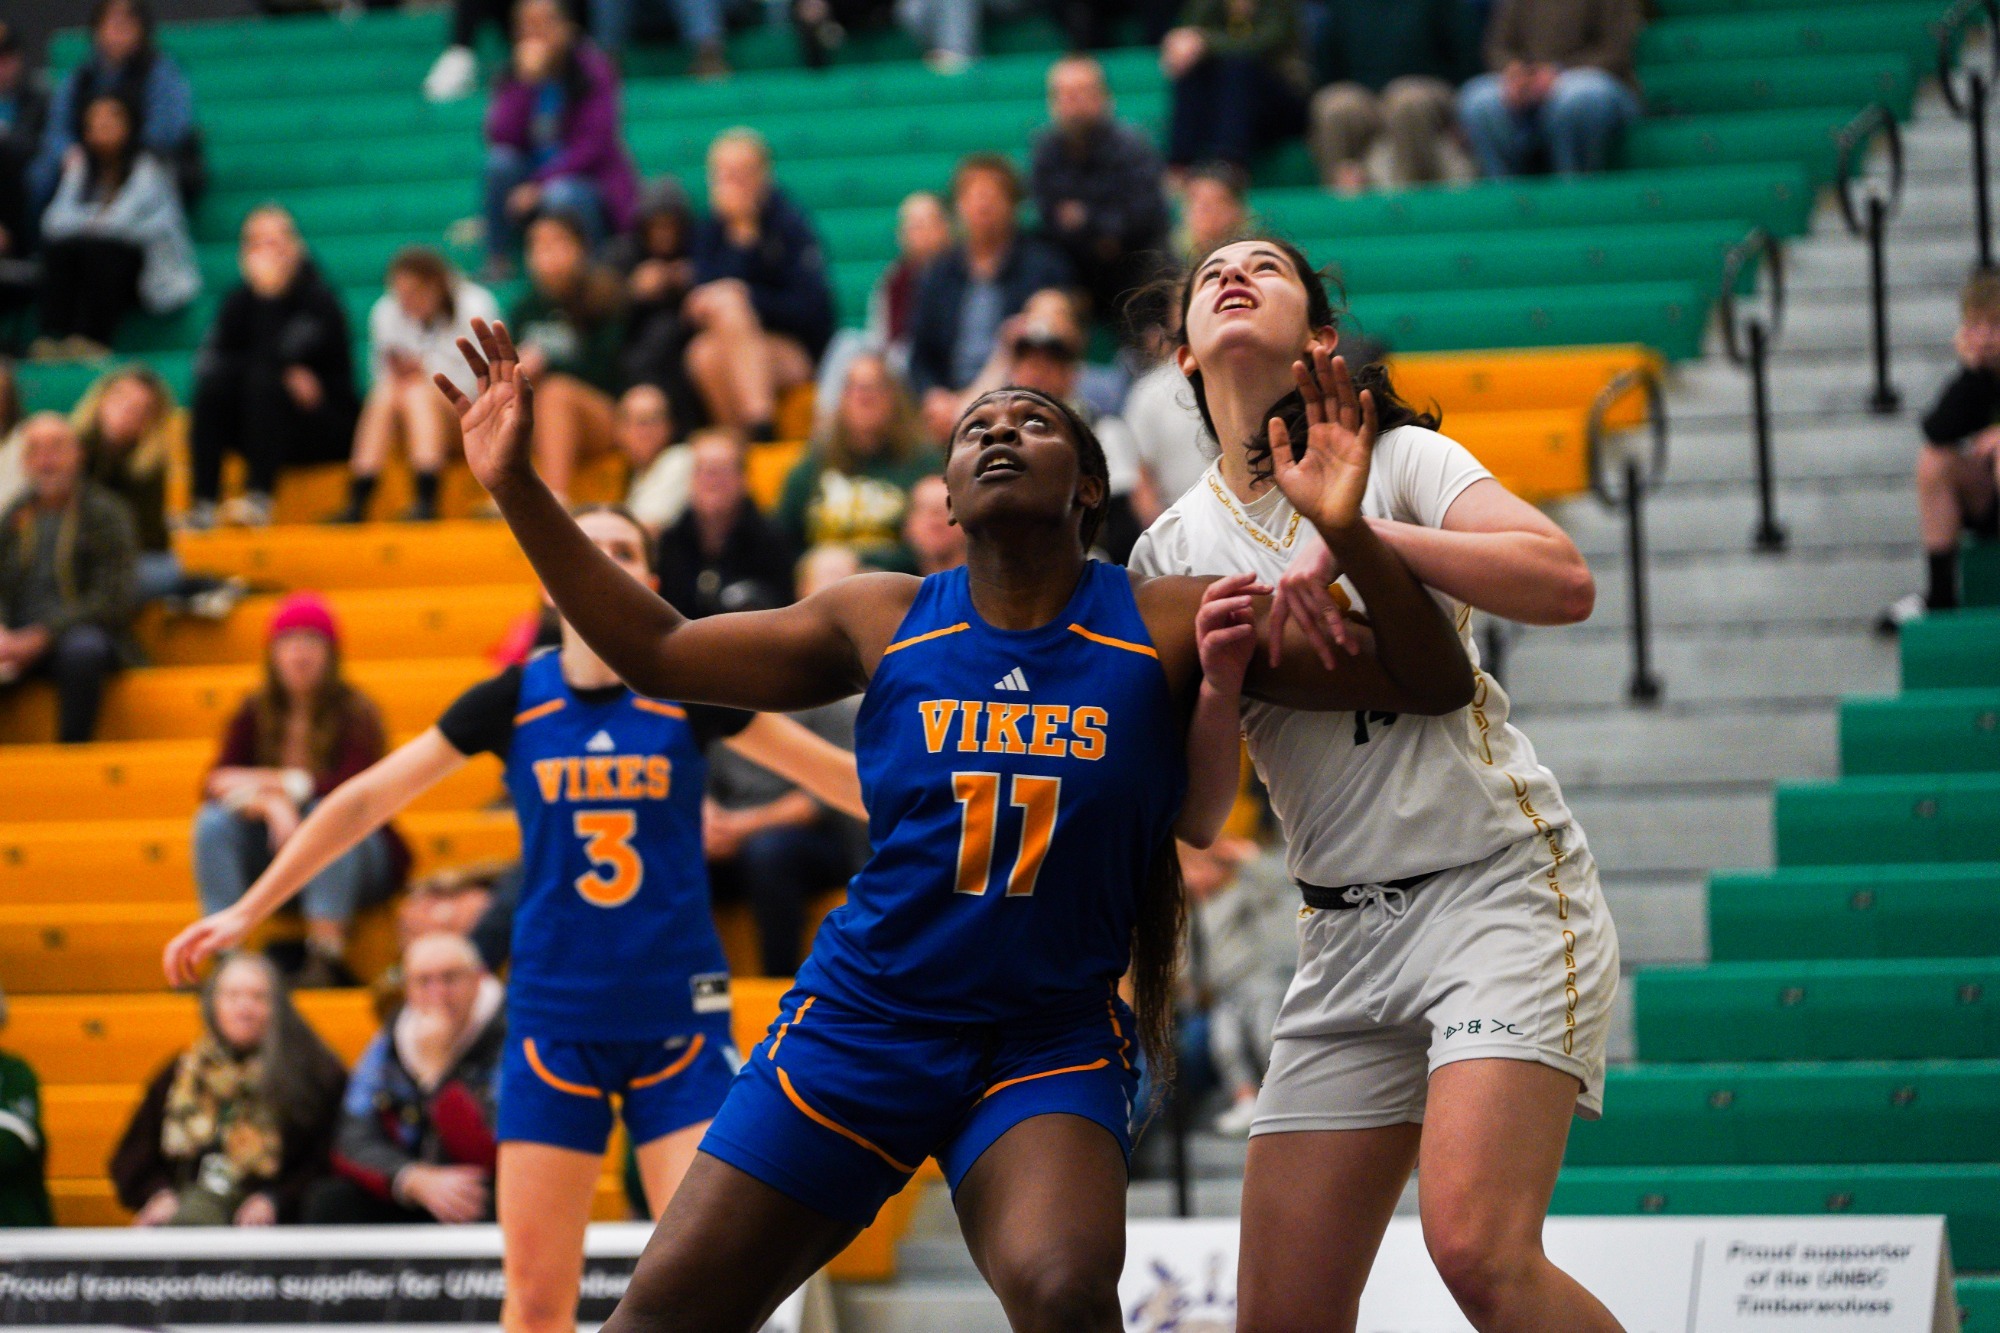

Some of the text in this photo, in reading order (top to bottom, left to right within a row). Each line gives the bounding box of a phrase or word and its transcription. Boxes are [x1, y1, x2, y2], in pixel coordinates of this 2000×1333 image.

[918, 699, 1108, 761] VIKES
[532, 753, 672, 804] VIKES
[951, 771, 1062, 897] 11
[573, 809, 644, 908] 3
[1726, 1240, 1913, 1265] Proud supporter
[81, 1272, 277, 1305] transportation
[278, 1270, 395, 1304] supplier
[1745, 1268, 1771, 1290] of
[1775, 1268, 1811, 1290] the
[1736, 1294, 1893, 1317] Timberwolves
